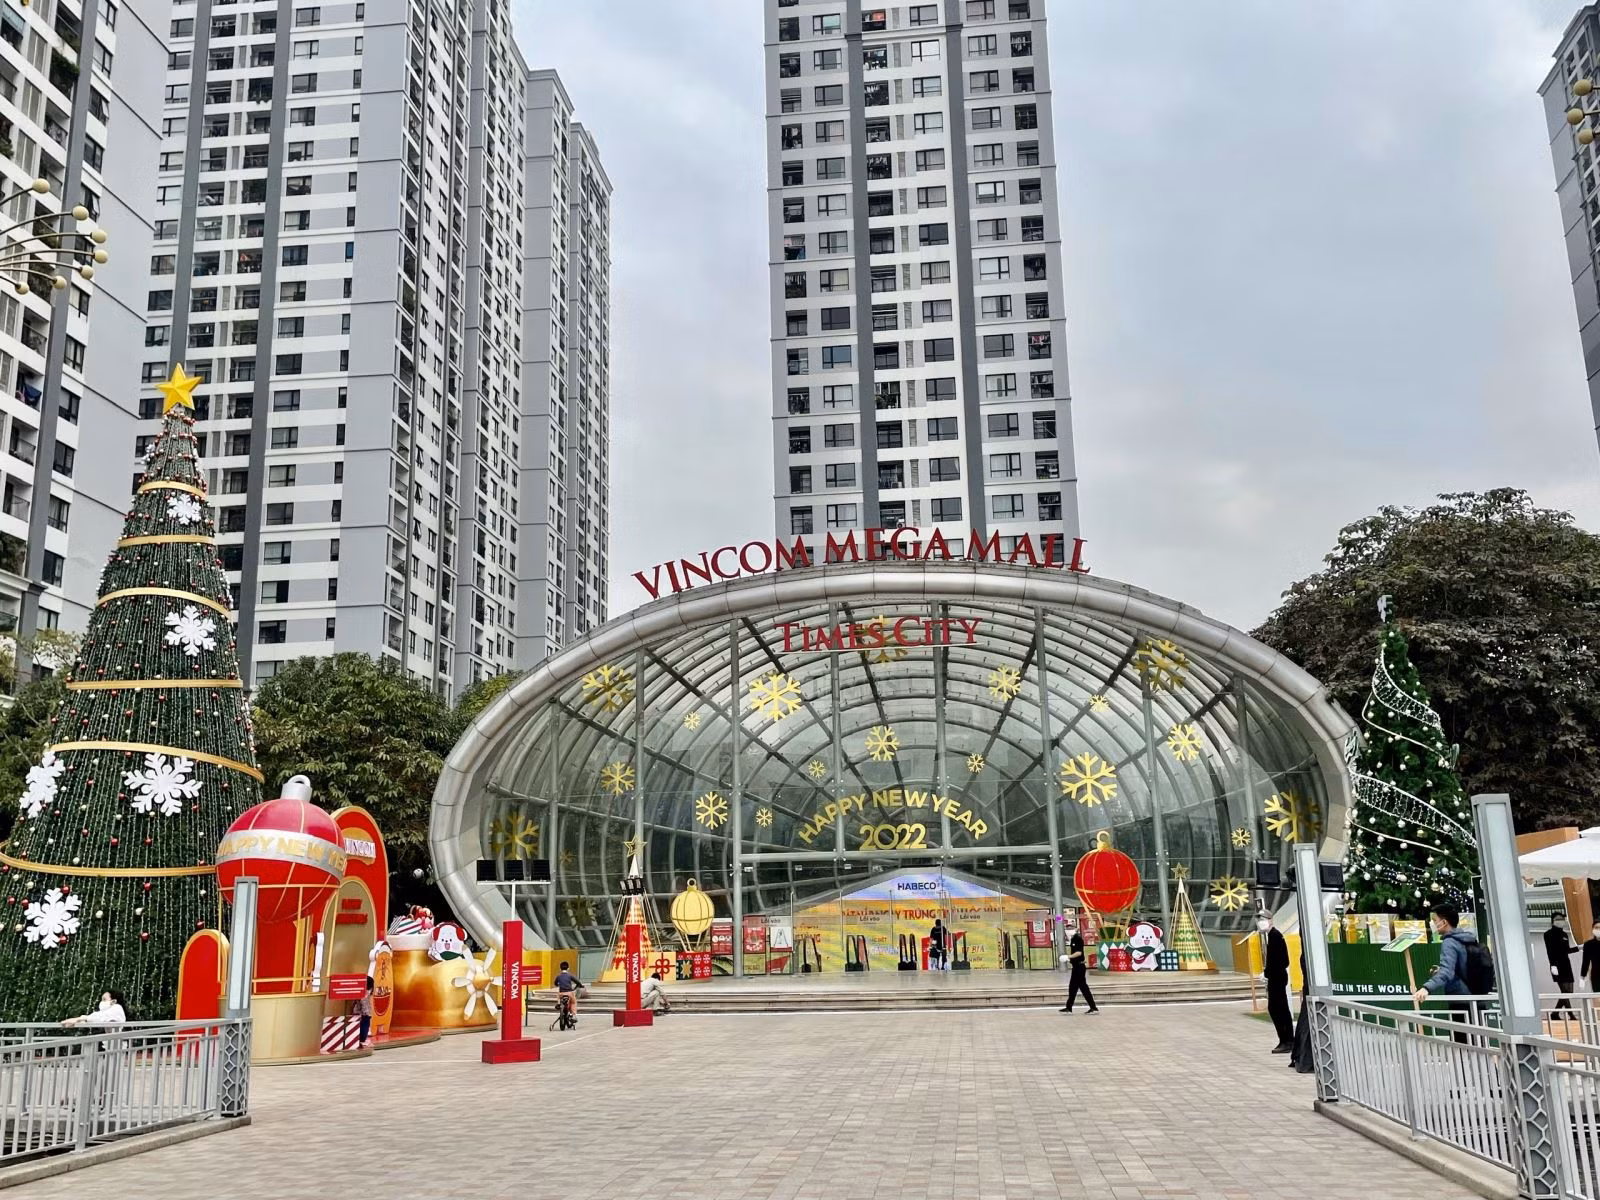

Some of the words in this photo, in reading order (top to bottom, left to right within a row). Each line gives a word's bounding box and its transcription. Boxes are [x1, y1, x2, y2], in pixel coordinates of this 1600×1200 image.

[631, 535, 811, 600] VINCOM
[823, 526, 954, 565] MEGA
[966, 527, 1092, 573] MALL
[798, 793, 866, 844] HAPPY
[872, 789, 928, 808] NEW
[931, 794, 988, 840] YEAR
[275, 837, 325, 860] NEW
[858, 823, 927, 851] 2022
[897, 882, 937, 891] HABECO
[511, 961, 519, 1000] VINCOM
[632, 952, 640, 984] VINCOM
[1345, 984, 1354, 992] IN
[1356, 984, 1374, 993] THE
[1378, 984, 1411, 993] WORL
